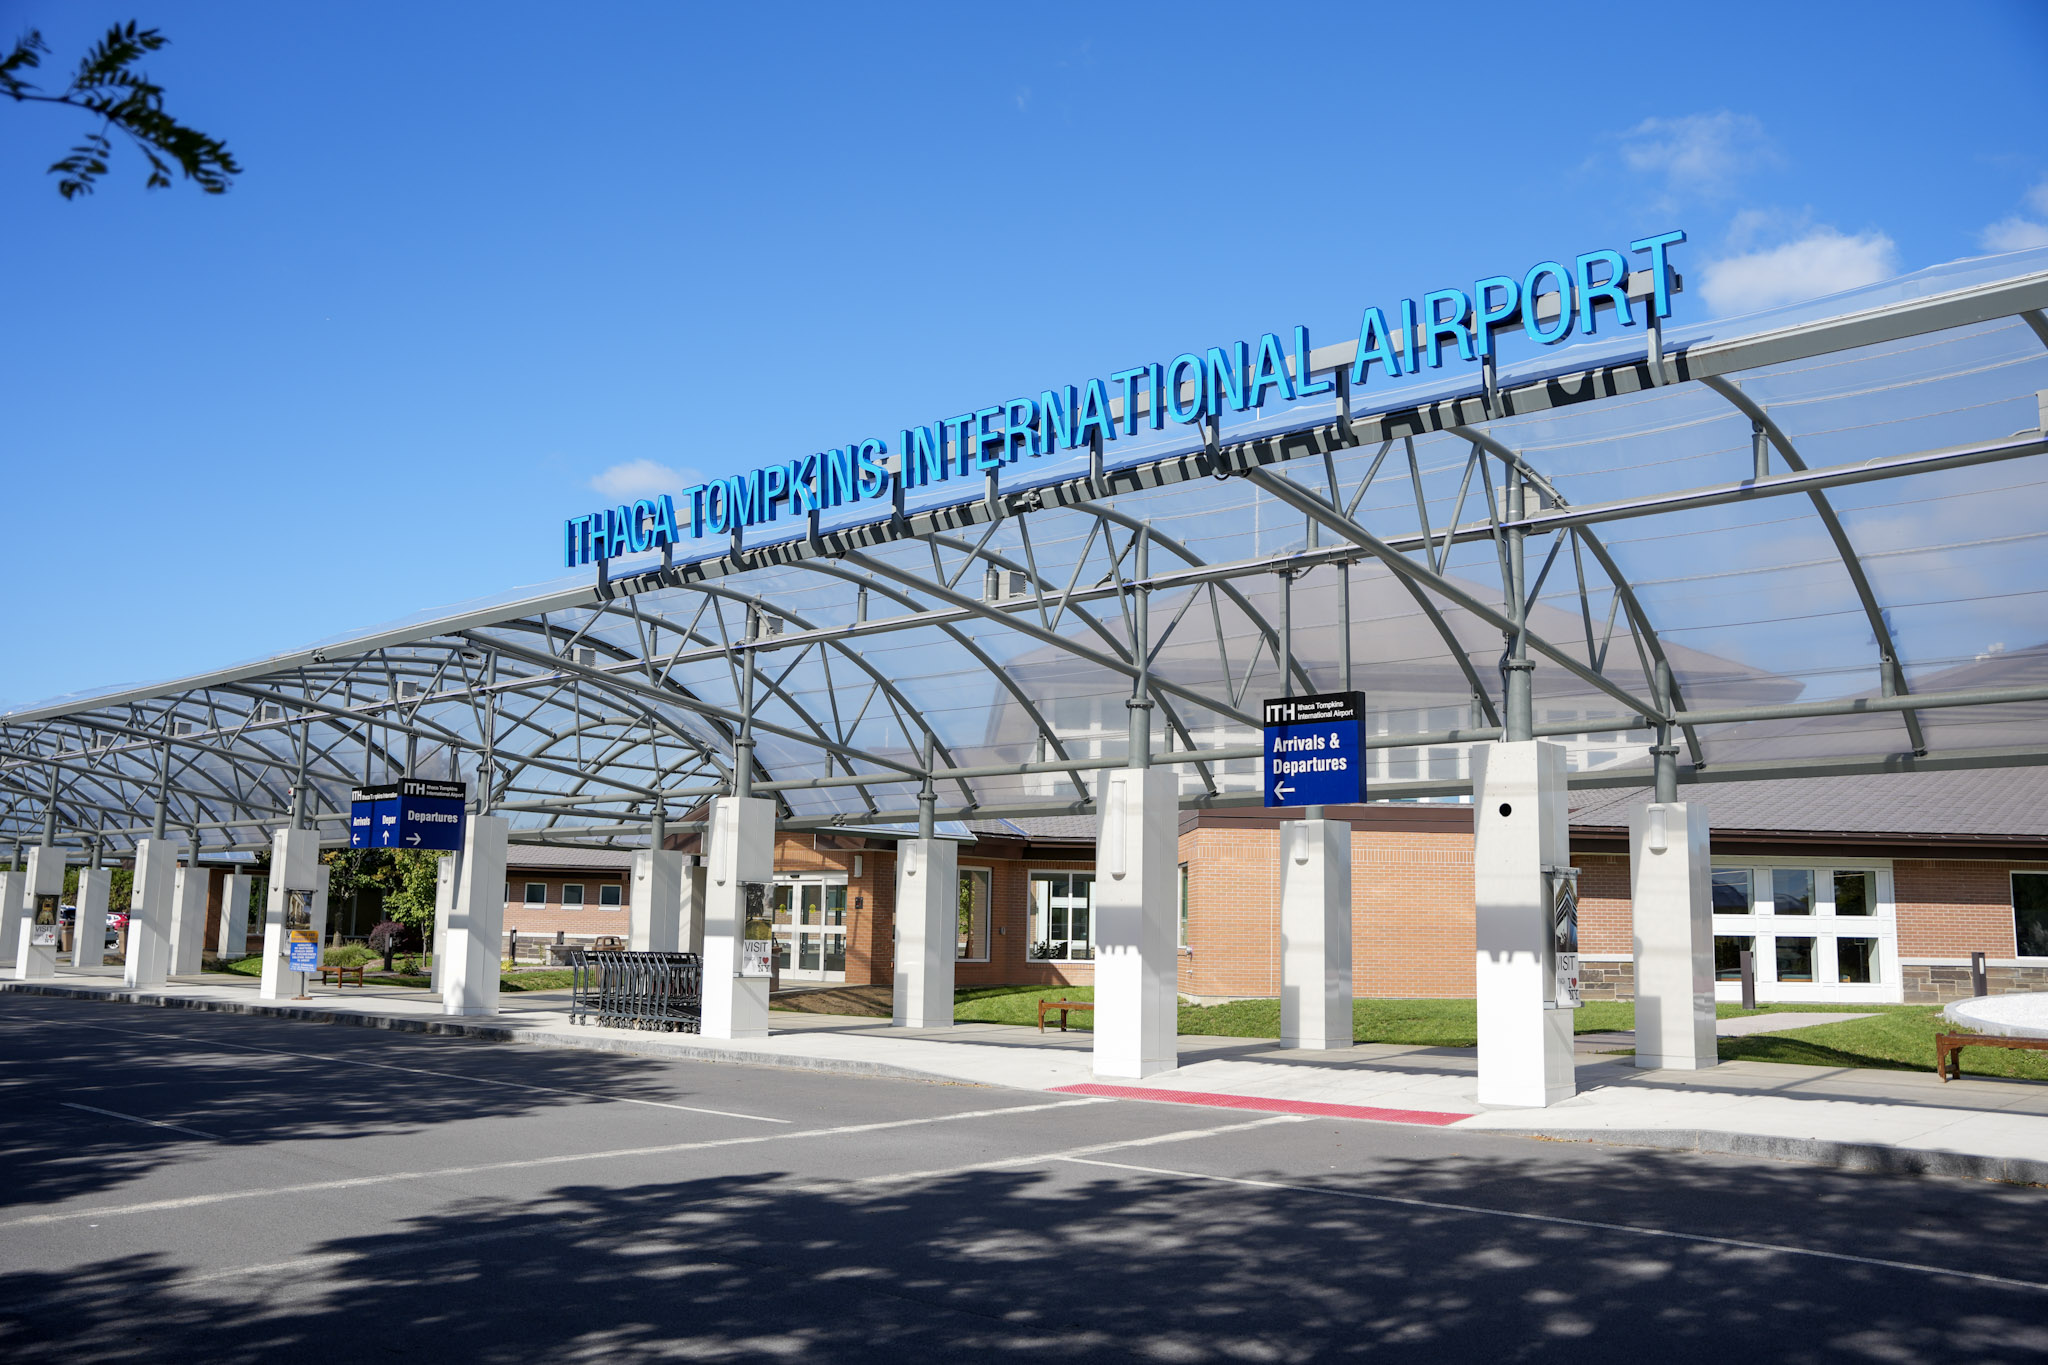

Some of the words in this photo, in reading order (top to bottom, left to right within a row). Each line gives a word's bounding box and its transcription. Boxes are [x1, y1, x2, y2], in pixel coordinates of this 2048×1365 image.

[564, 494, 679, 568] ITHACA
[683, 437, 888, 538] TOMPKINS
[900, 325, 1335, 489] INTERNATIONAL
[1352, 229, 1687, 386] AIRPORT
[1297, 703, 1315, 711] Ithaca
[1315, 700, 1344, 710] Tompkins
[1266, 703, 1296, 722] ITH
[1297, 710, 1333, 720] International
[1333, 709, 1353, 718] Airport
[1273, 734, 1326, 753] Arrivals
[1329, 732, 1340, 749] &
[1273, 757, 1348, 777] Departures
[404, 782, 426, 795] ITH
[352, 790, 362, 801] ITH
[353, 816, 370, 826] Arrivals
[407, 810, 459, 824] Departures
[35, 925, 53, 933] VISIT
[744, 941, 768, 952] VISIT
[1556, 955, 1576, 971] VISIT
